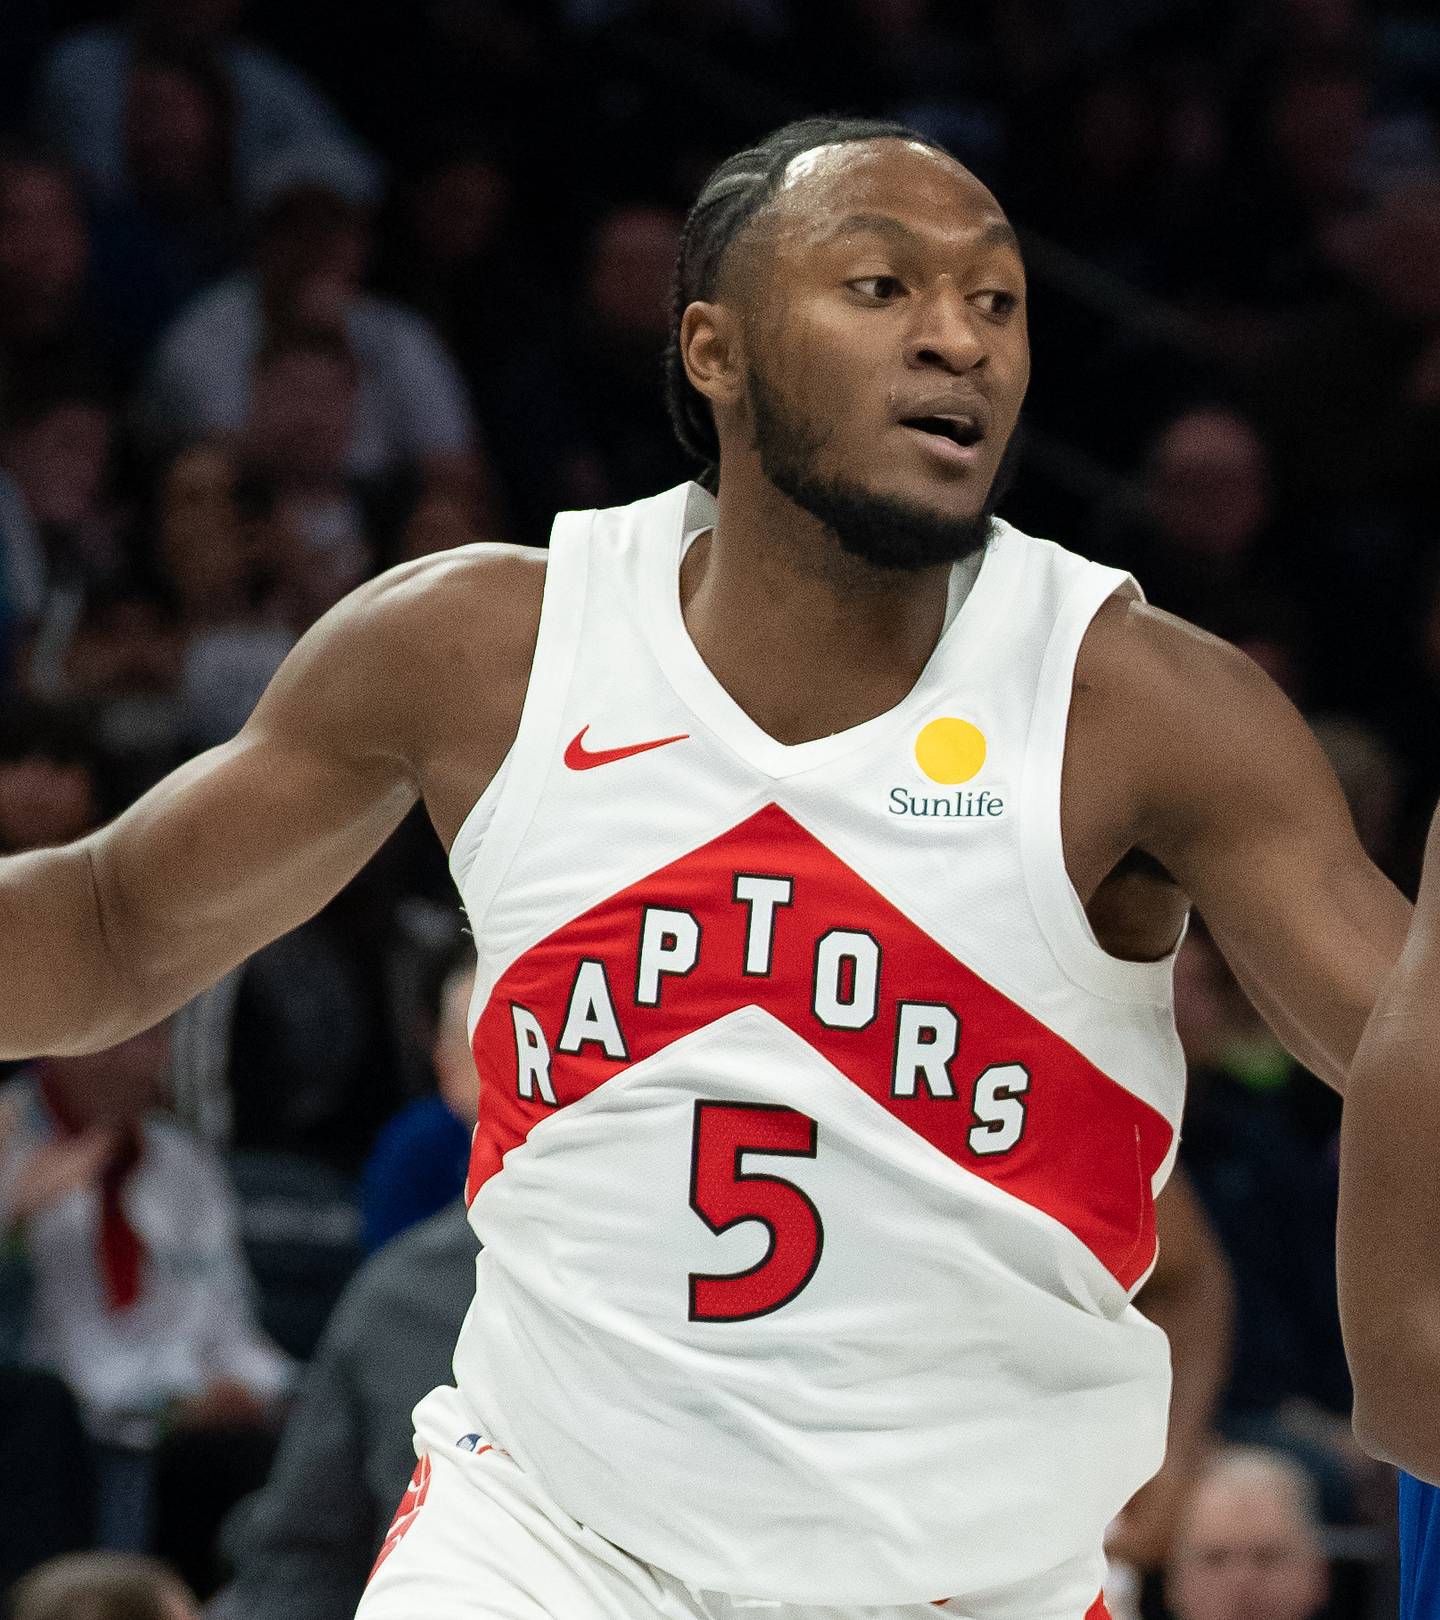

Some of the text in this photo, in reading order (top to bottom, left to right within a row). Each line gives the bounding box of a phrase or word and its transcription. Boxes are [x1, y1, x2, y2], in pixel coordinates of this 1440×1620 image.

[889, 787, 1004, 817] Sunlife
[511, 873, 1029, 1156] RAPTORS
[688, 1098, 825, 1323] 5
